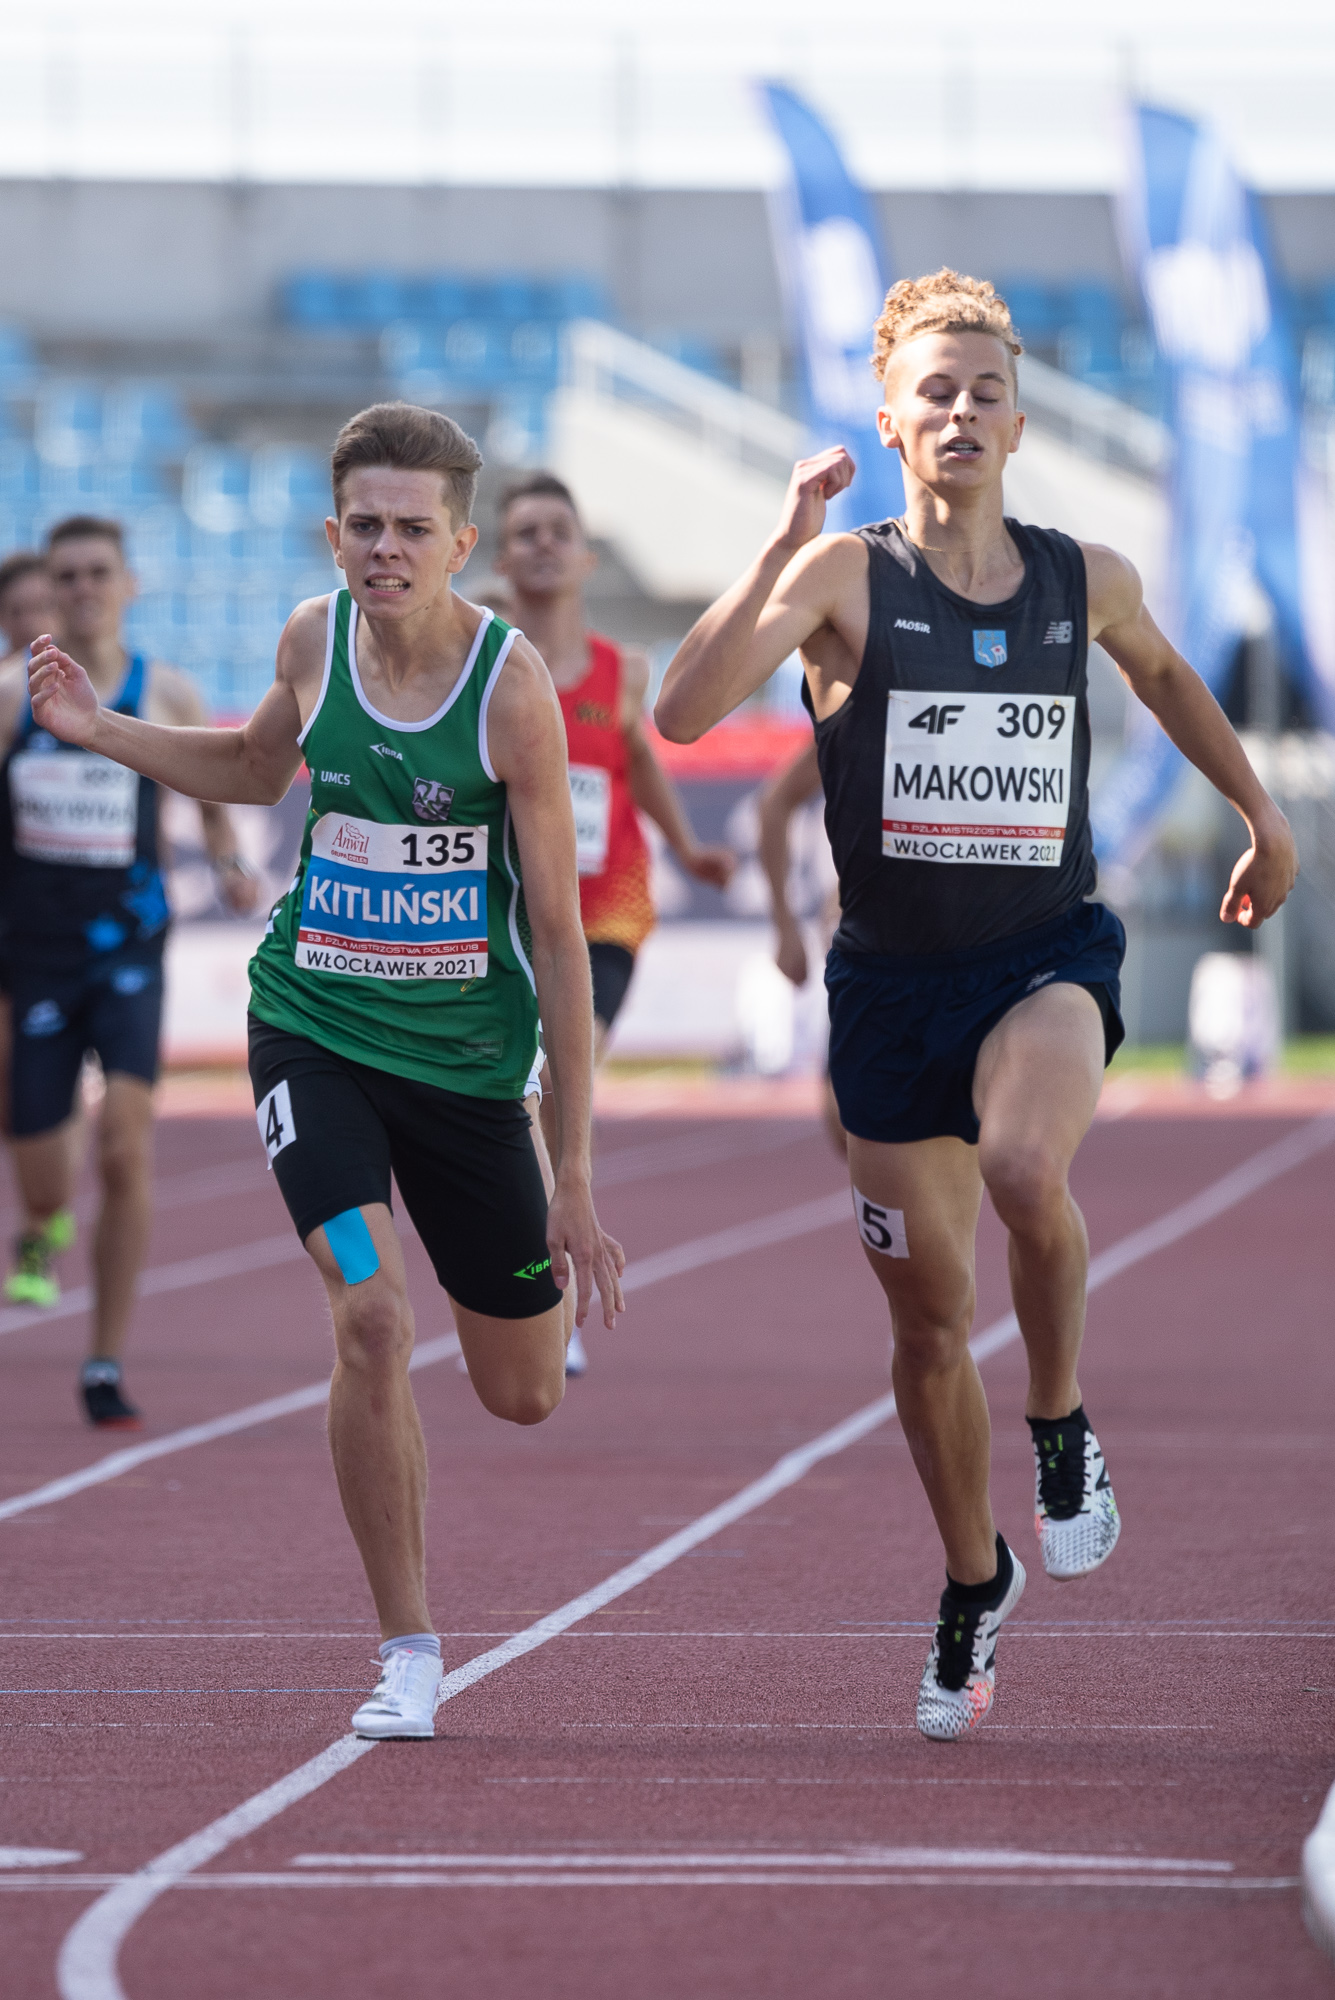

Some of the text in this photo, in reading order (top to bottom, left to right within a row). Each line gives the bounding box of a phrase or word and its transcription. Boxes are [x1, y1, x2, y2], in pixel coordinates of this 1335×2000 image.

[908, 704, 966, 735] 4F
[996, 702, 1066, 740] 309
[320, 770, 351, 786] UMCS
[893, 763, 1063, 804] MAKOWSKI
[331, 825, 370, 854] Anwil
[911, 824, 940, 834] PZLA
[941, 826, 1017, 837] MISTRZOSTWA
[401, 832, 475, 867] 135
[893, 838, 1056, 862] WŁOCŁAWEK 2021
[308, 875, 479, 926] KITLIŃSKI
[325, 936, 349, 948] PZLA
[349, 941, 421, 955] MISTRZOSTWA
[423, 945, 459, 954] POLSKI
[461, 943, 479, 952] U18
[306, 949, 476, 977] WŁOCŁAWEK 2021
[265, 1094, 284, 1150] 4
[863, 1201, 892, 1250] 5
